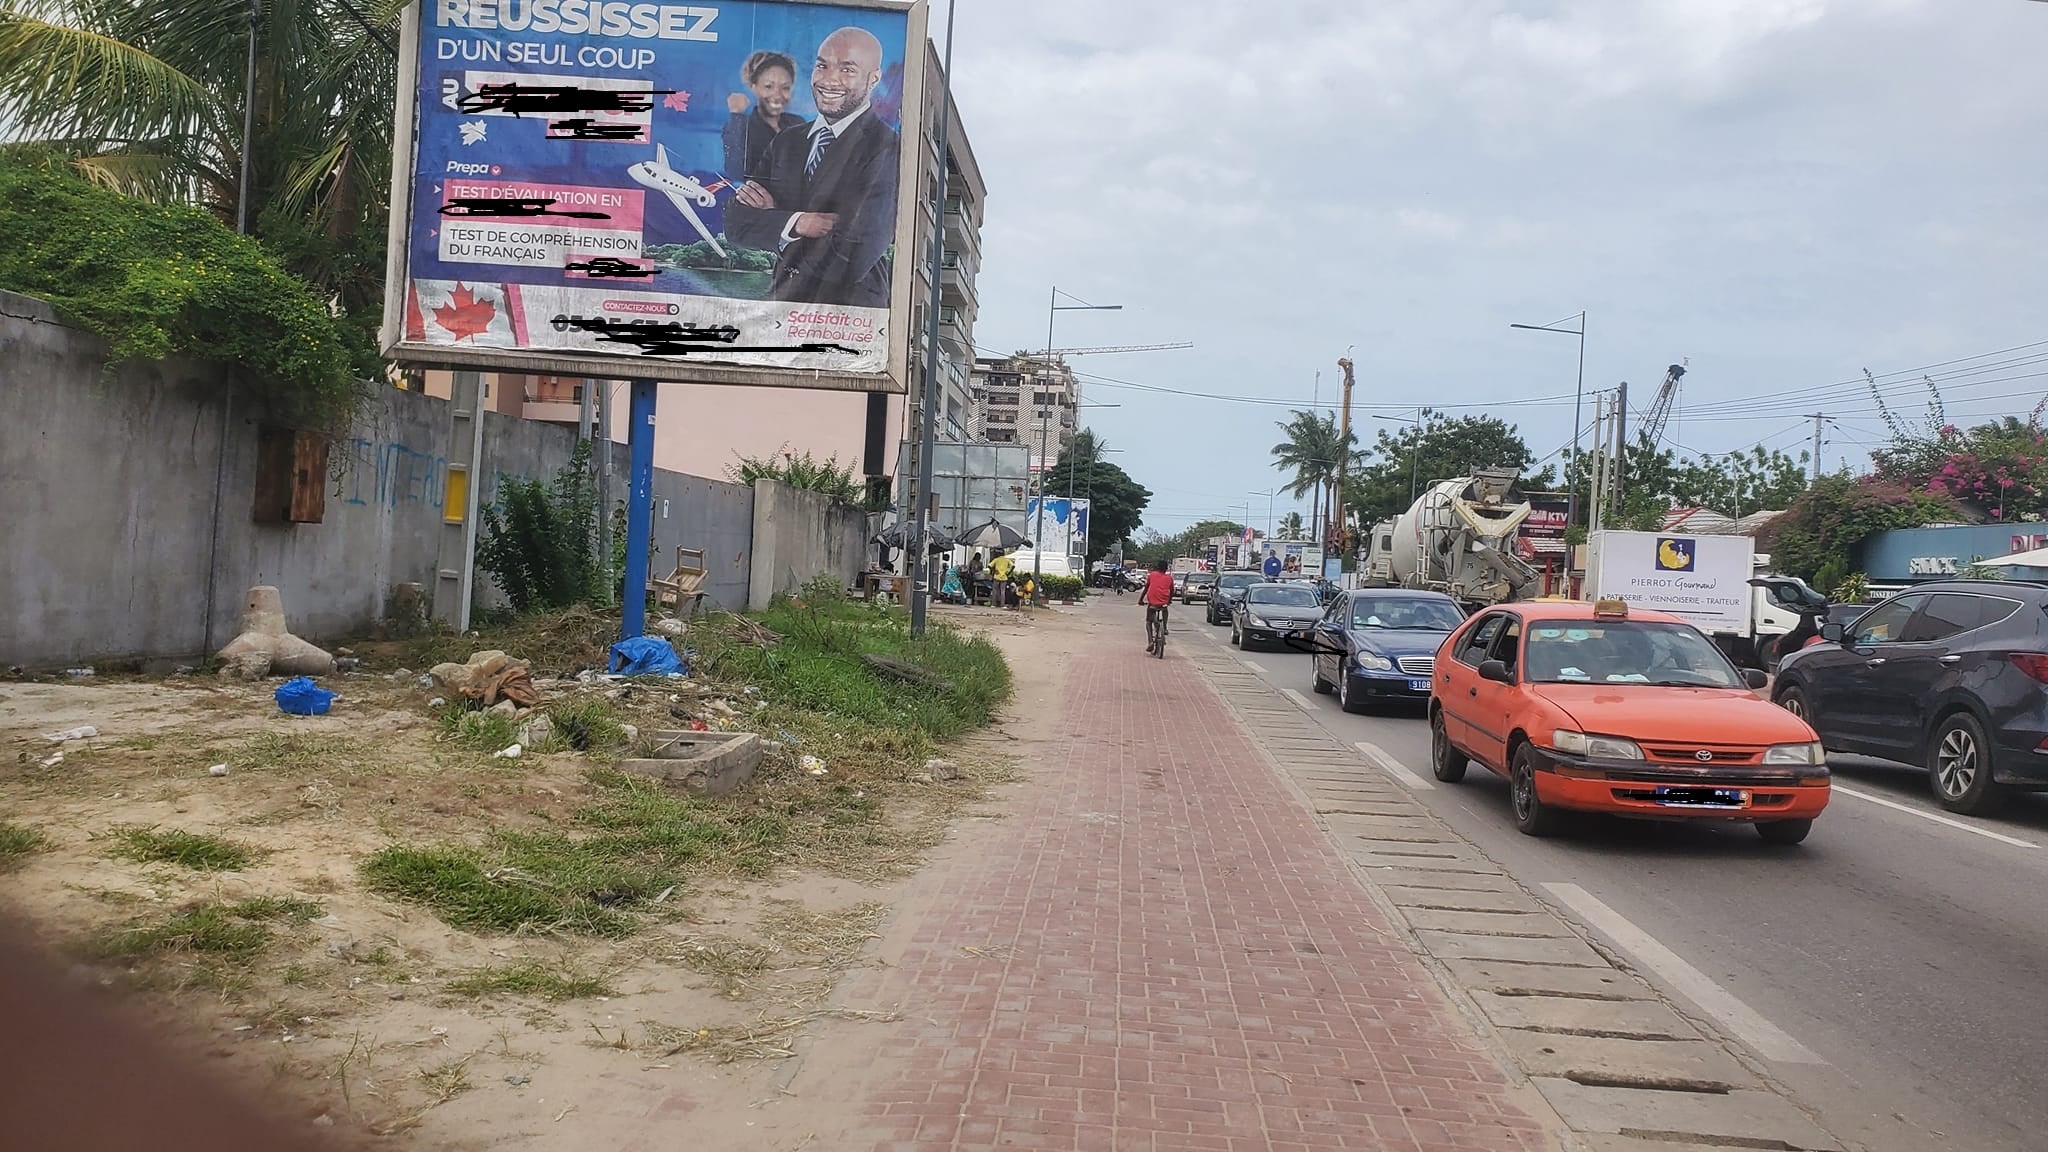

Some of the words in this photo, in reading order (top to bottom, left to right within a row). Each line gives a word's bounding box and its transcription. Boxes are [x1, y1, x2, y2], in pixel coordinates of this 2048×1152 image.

[437, 38, 501, 62] D'UN
[507, 42, 573, 66] SEUL
[578, 47, 656, 70] COUP
[442, 78, 460, 110] AU
[446, 160, 490, 175] Prepa
[452, 185, 488, 199] TEST
[601, 195, 622, 207] EN
[450, 229, 484, 242] TEST
[487, 231, 506, 243] DE
[510, 232, 638, 250] COMPRÉHENSION
[449, 244, 473, 256] DU
[475, 245, 546, 262] FRANÇAIS
[604, 301, 666, 313] CONTACTEZ-NOUS
[787, 310, 849, 327] Satisfait
[852, 316, 873, 329] ou
[787, 325, 873, 343] Remboursé
[1548, 512, 1568, 522] KTV
[1631, 578, 1672, 588] PIERROT
[1649, 595, 1700, 605] VIENNOISERIE
[1706, 597, 1740, 606] TRAITEUR
